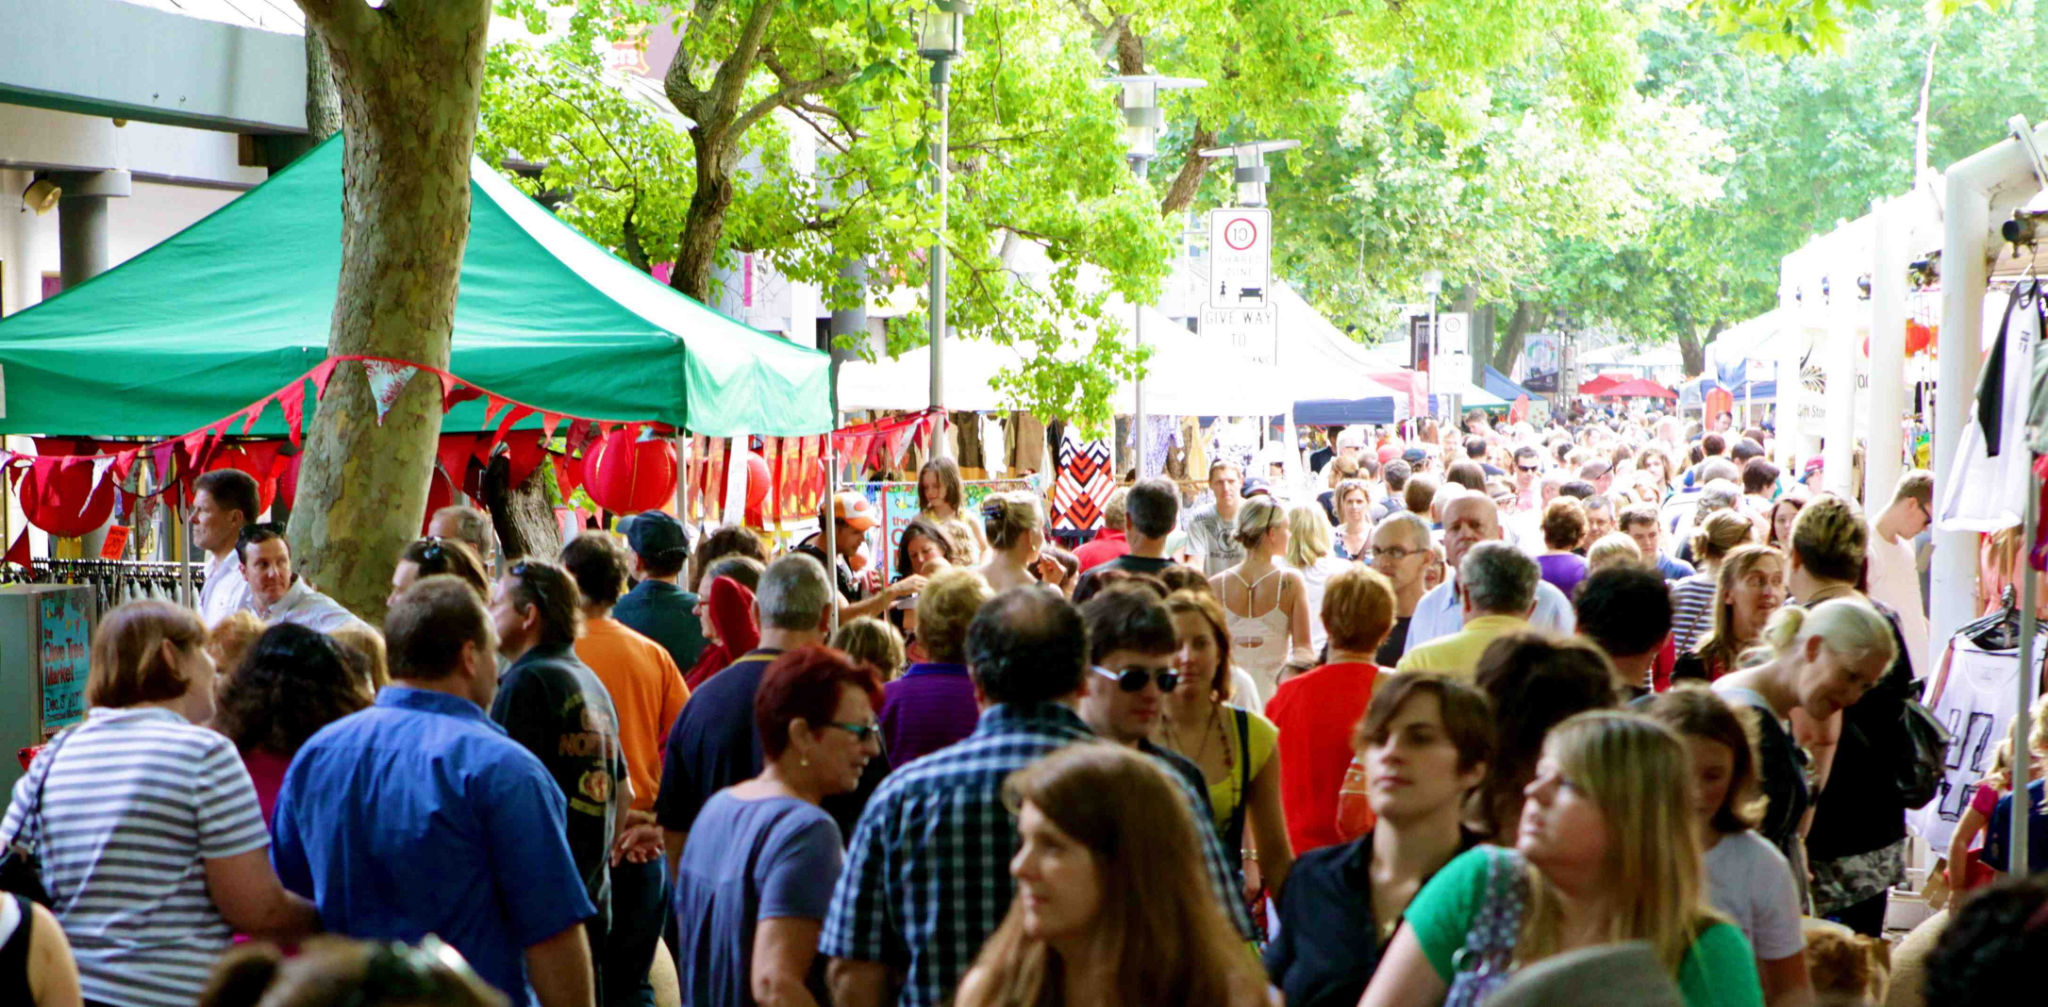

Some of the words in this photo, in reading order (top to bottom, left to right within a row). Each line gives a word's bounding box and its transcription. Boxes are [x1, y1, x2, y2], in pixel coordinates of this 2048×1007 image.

[1233, 227, 1248, 242] 10
[1217, 254, 1264, 265] SHARED
[1205, 311, 1235, 325] GIVE
[1242, 311, 1272, 325] WAY
[1231, 333, 1247, 347] TO
[892, 516, 910, 527] the
[44, 642, 64, 663] Olive
[66, 638, 84, 658] Tree
[45, 666, 74, 687] Market
